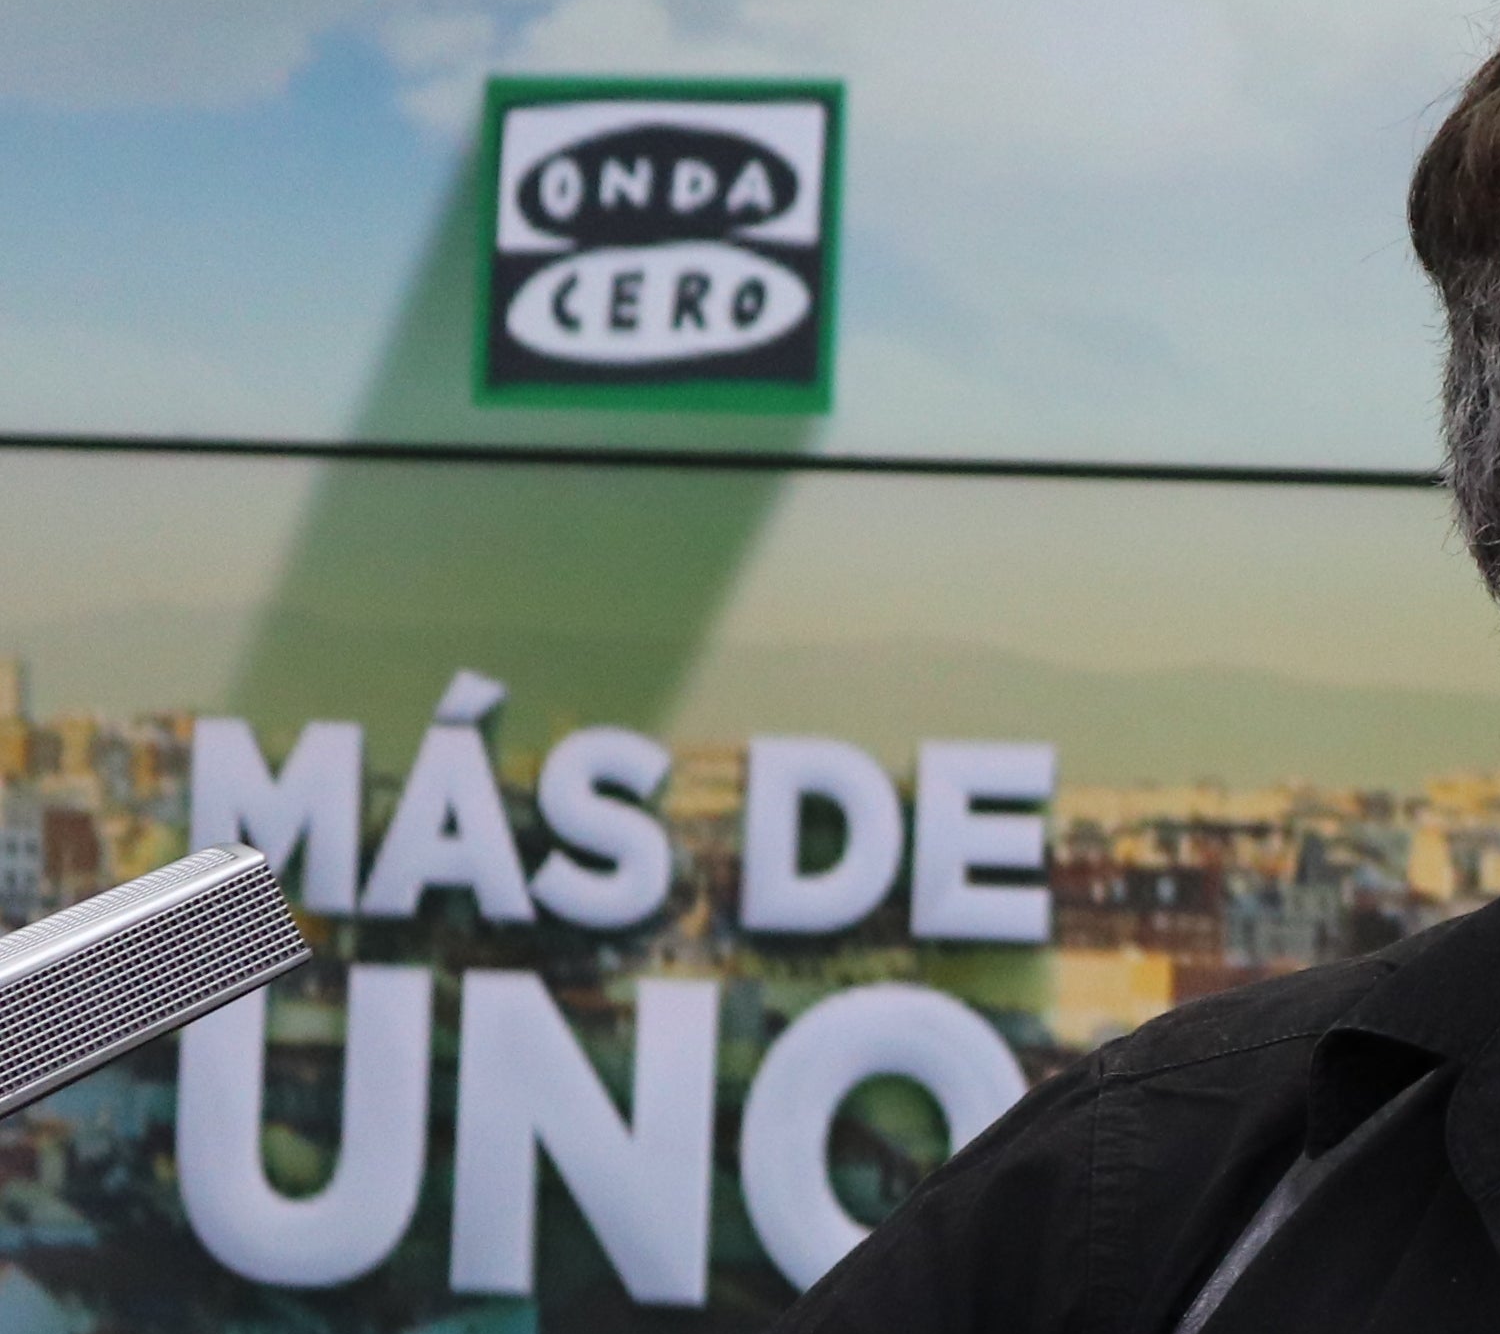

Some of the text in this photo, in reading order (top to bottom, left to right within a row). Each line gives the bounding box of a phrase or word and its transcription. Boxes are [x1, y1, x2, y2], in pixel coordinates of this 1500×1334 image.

[537, 153, 778, 222] ONDA
[550, 267, 772, 334] CERO
[188, 669, 1059, 944] MÁS DE
[176, 965, 1030, 1308] UNO
